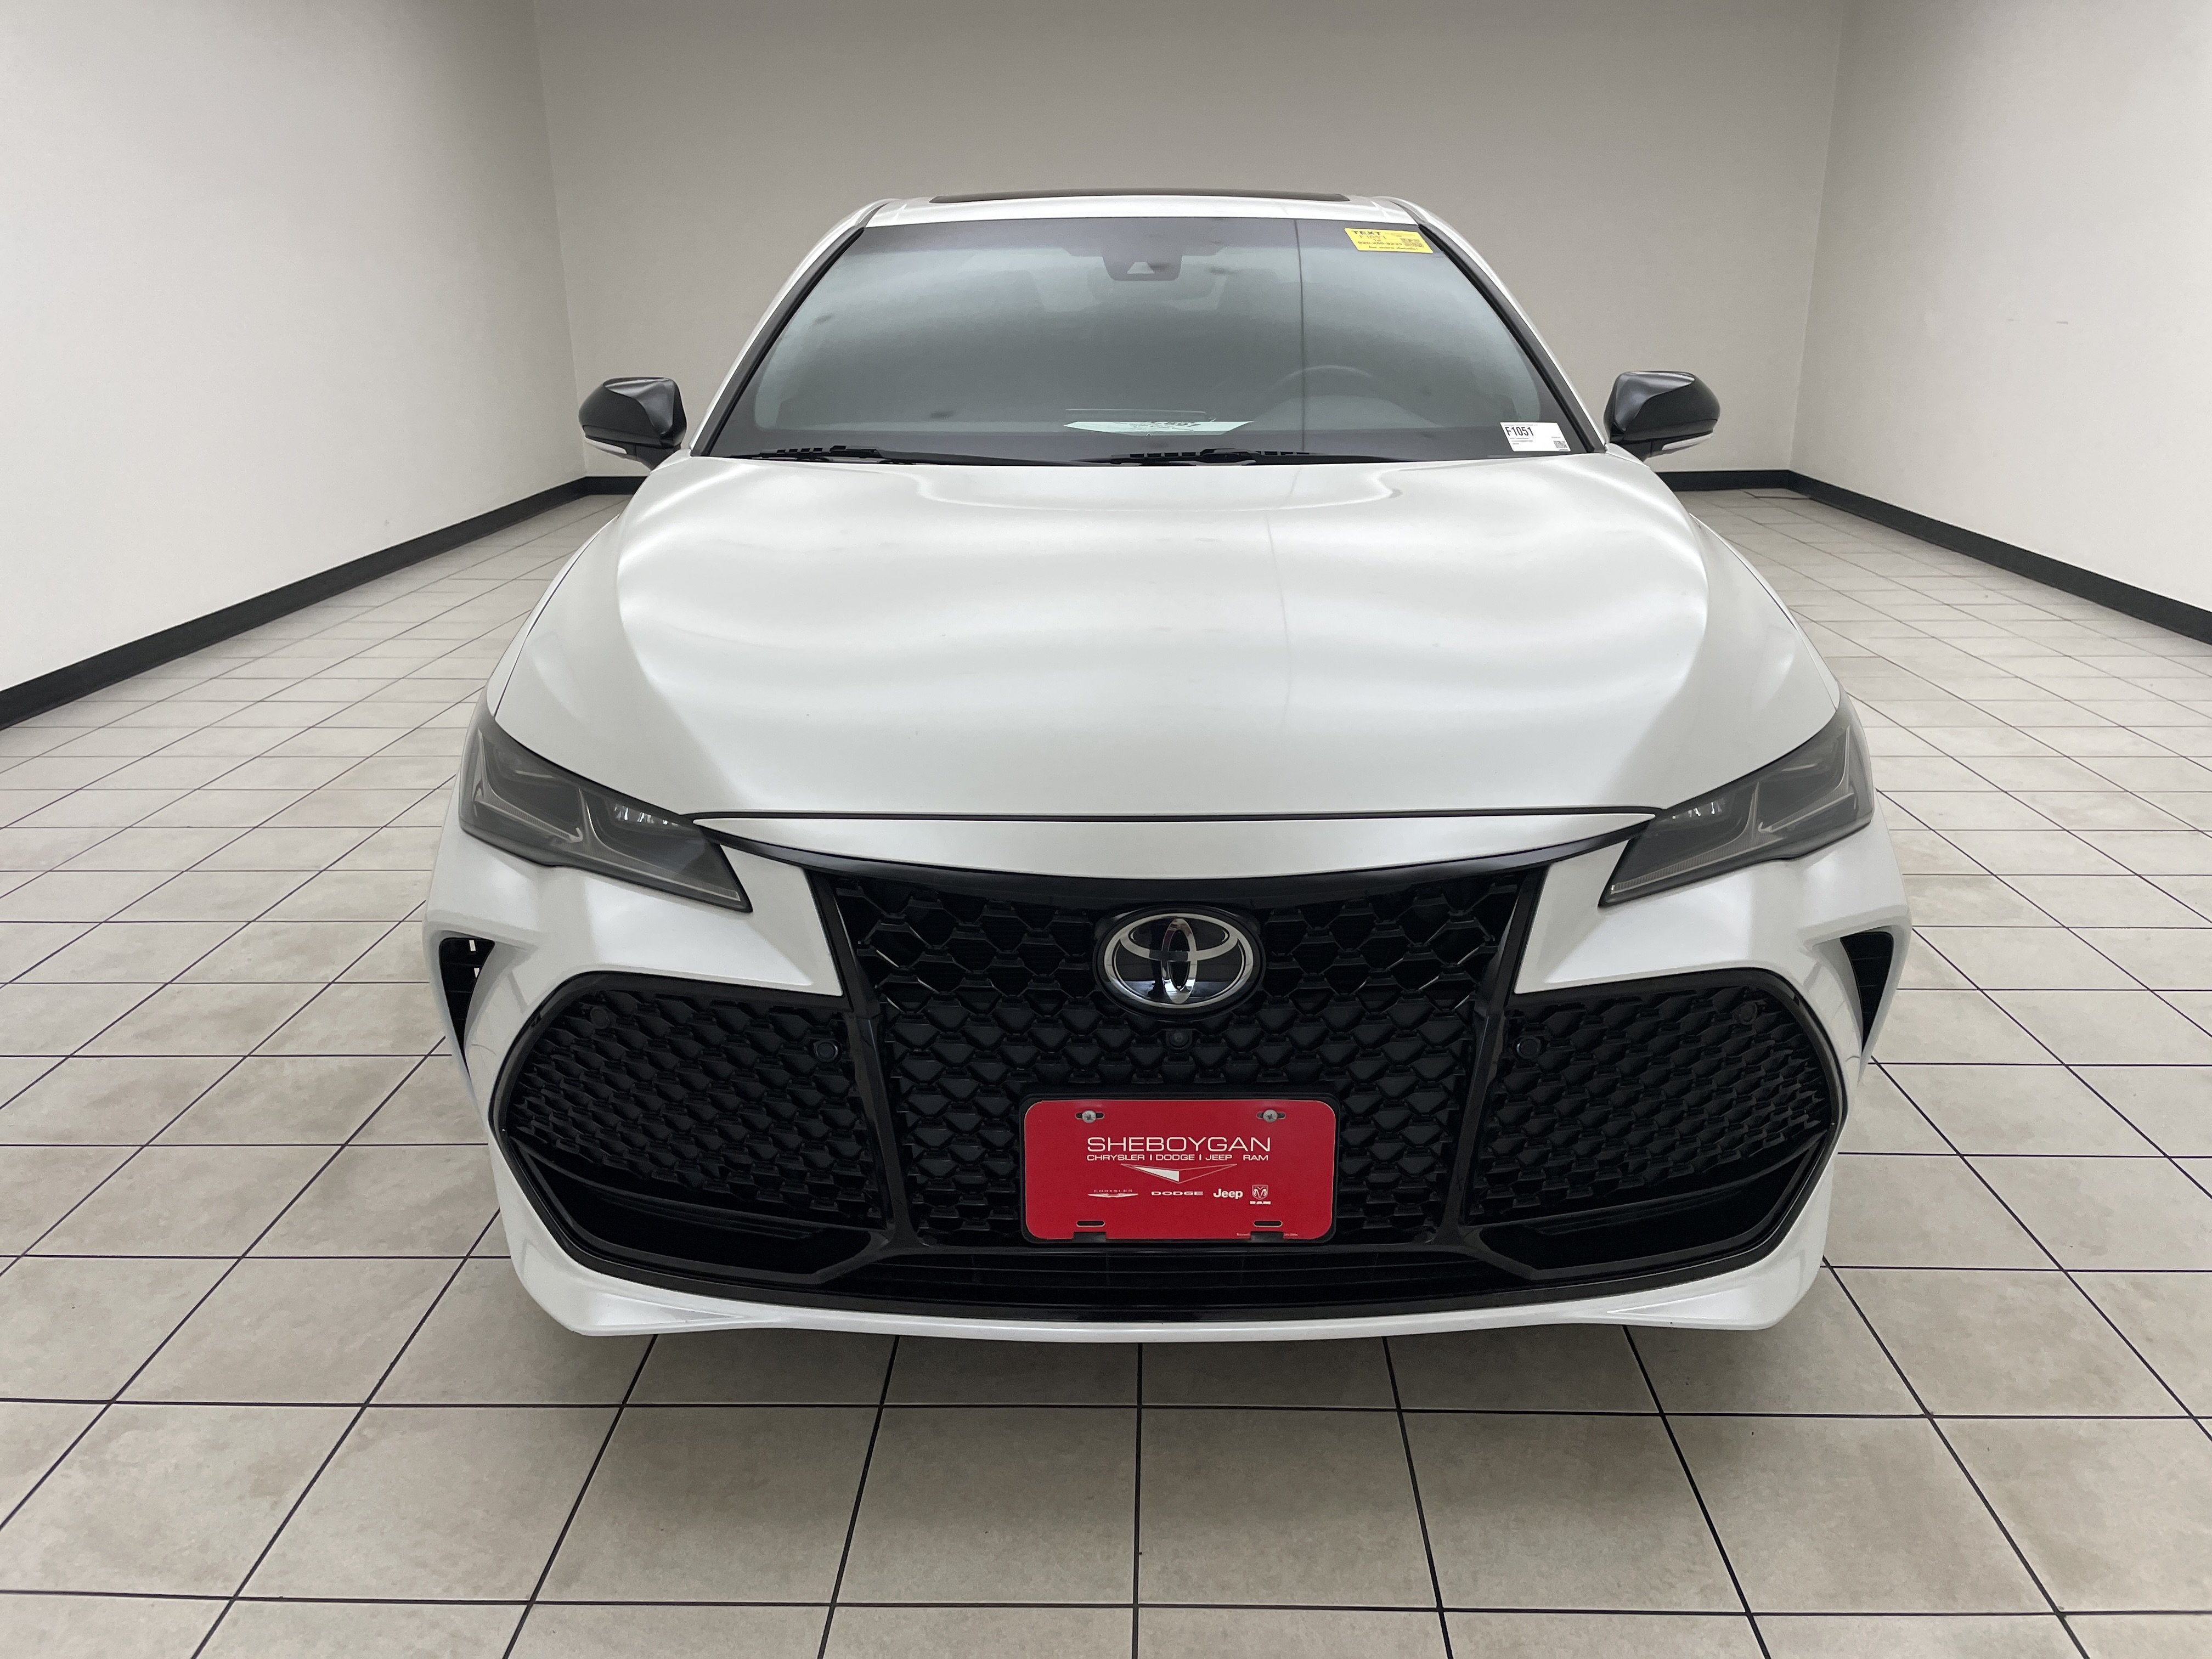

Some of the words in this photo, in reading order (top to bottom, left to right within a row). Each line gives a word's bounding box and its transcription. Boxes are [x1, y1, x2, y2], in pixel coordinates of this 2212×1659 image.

[1504, 426, 1534, 436] F1051
[1087, 1137, 1271, 1152] SHEBOYGAN
[1213, 1188, 1243, 1200] Jeep
